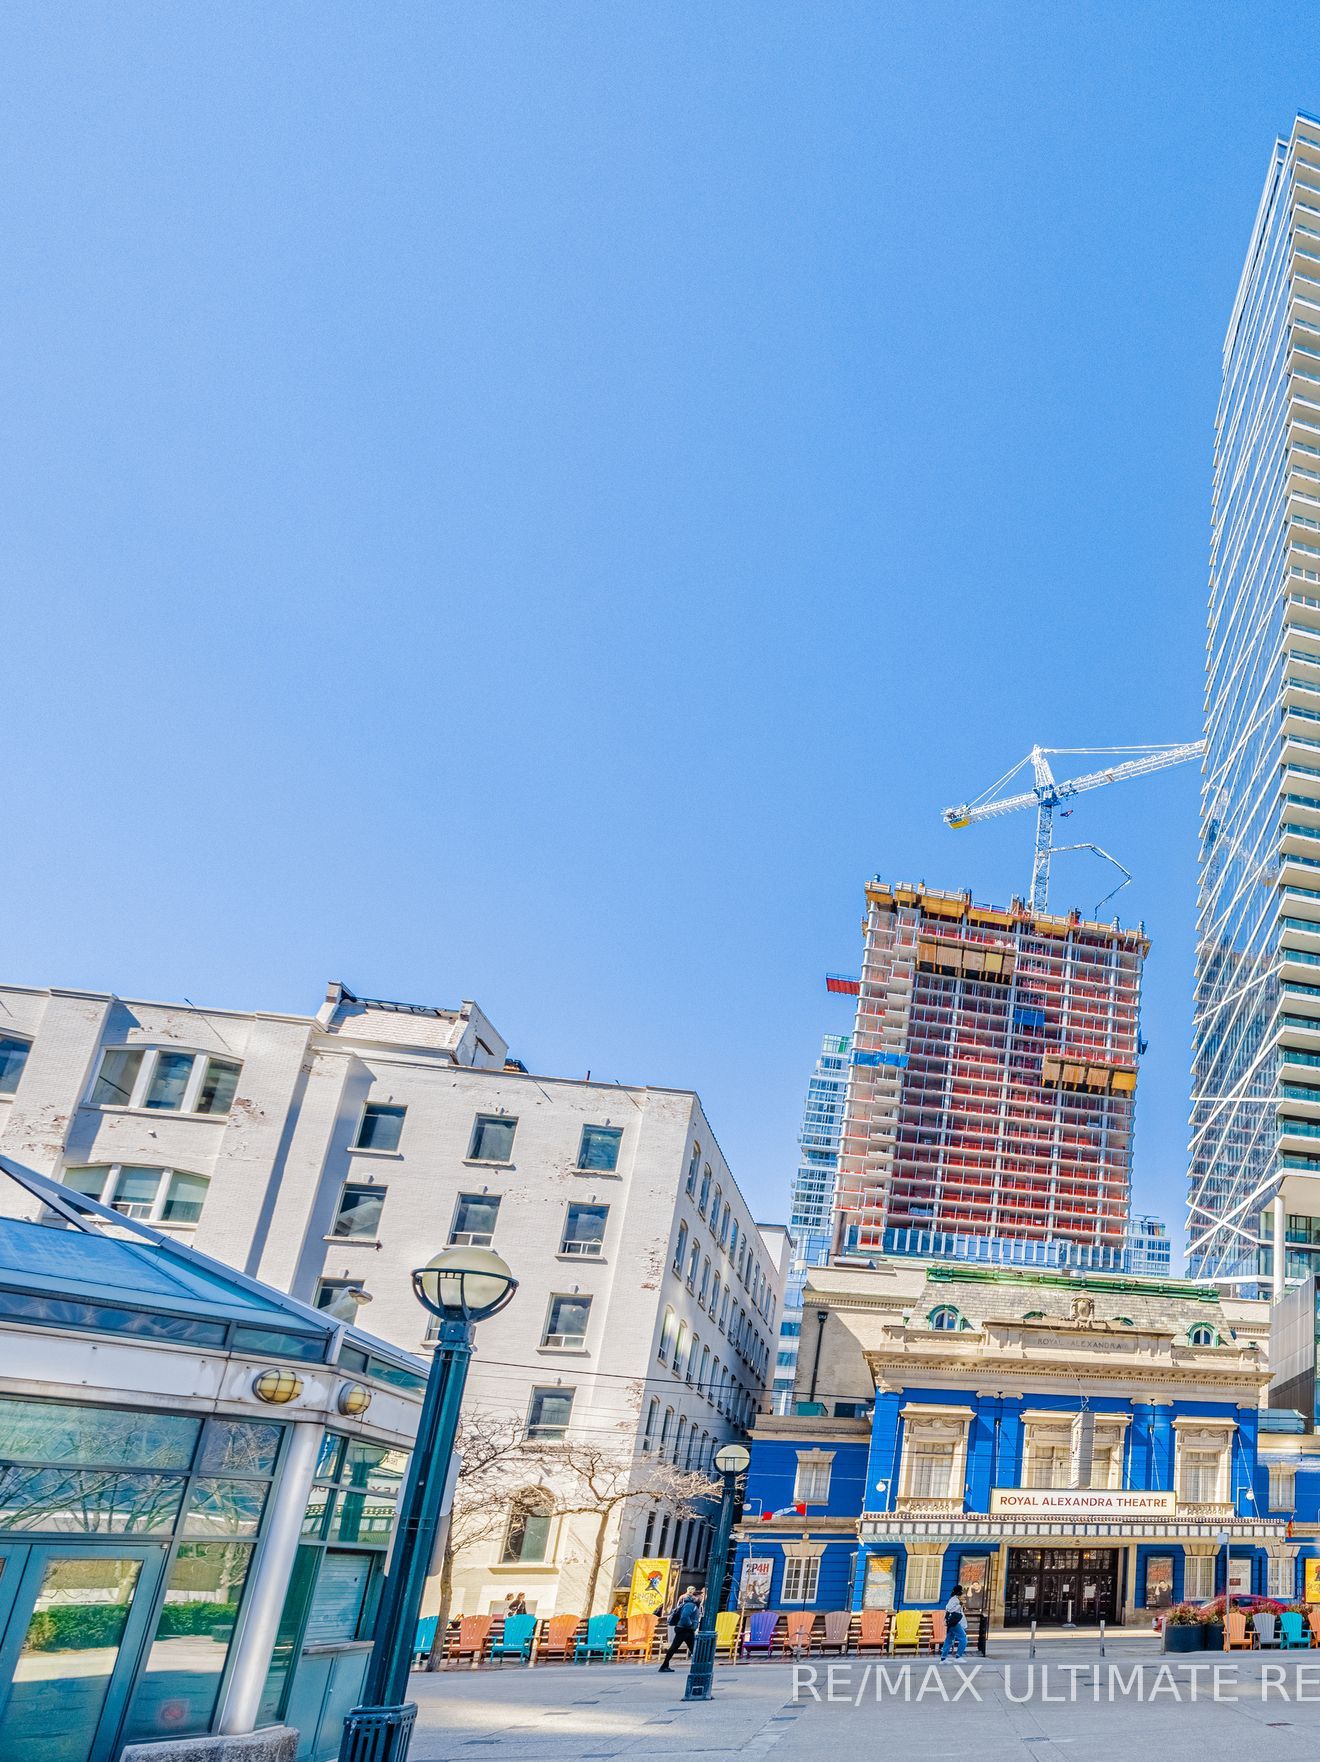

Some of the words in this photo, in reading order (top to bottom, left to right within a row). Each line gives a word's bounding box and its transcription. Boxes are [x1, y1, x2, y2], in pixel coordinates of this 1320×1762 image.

[1000, 1496, 1038, 1506] ROYAL
[1042, 1497, 1113, 1507] ALEXANDRA
[1116, 1498, 1167, 1508] THEATRE
